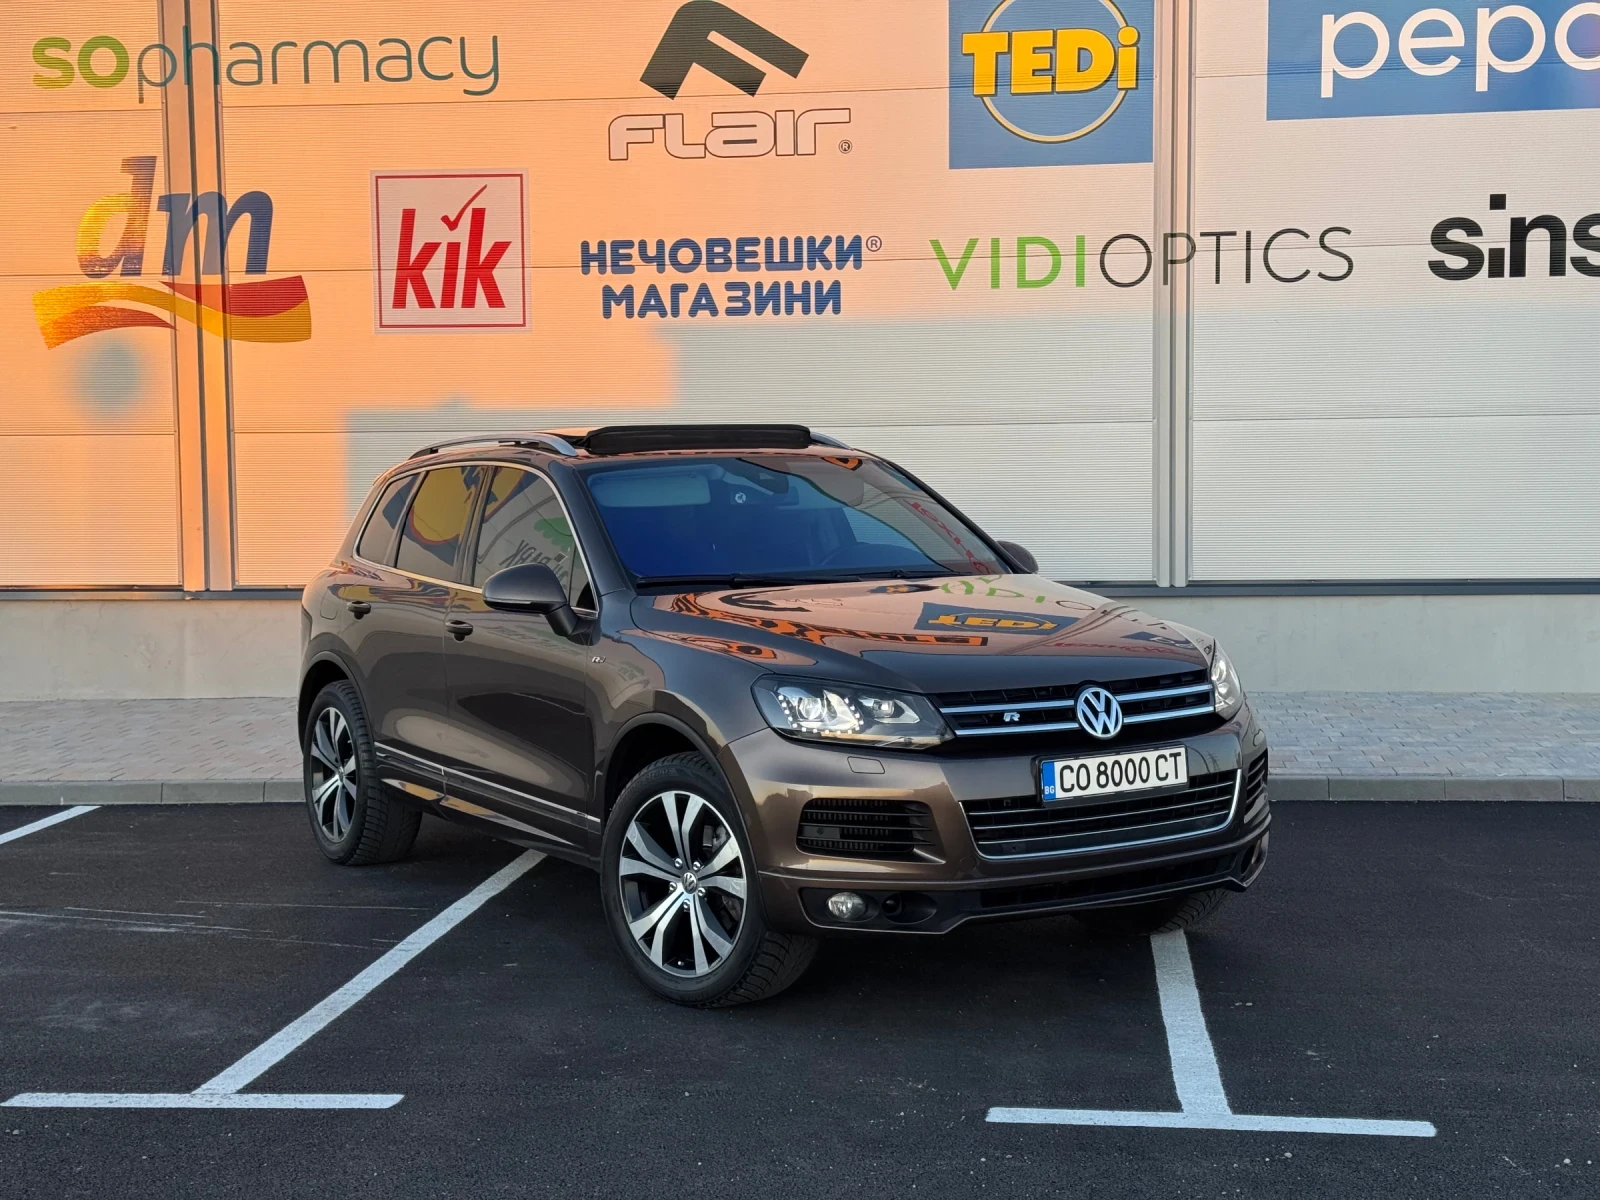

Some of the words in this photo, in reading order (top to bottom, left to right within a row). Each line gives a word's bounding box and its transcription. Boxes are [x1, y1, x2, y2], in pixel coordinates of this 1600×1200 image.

[32, 25, 500, 104] sopharmacy
[962, 25, 1140, 98] TEDi
[76, 155, 274, 280] dm
[392, 184, 512, 310] kik
[601, 280, 841, 320] МАГАЗИНИ
[1043, 784, 1055, 795] BG
[1058, 762, 1091, 794] CO
[1096, 756, 1151, 789] 8000
[1154, 751, 1182, 782] CT
